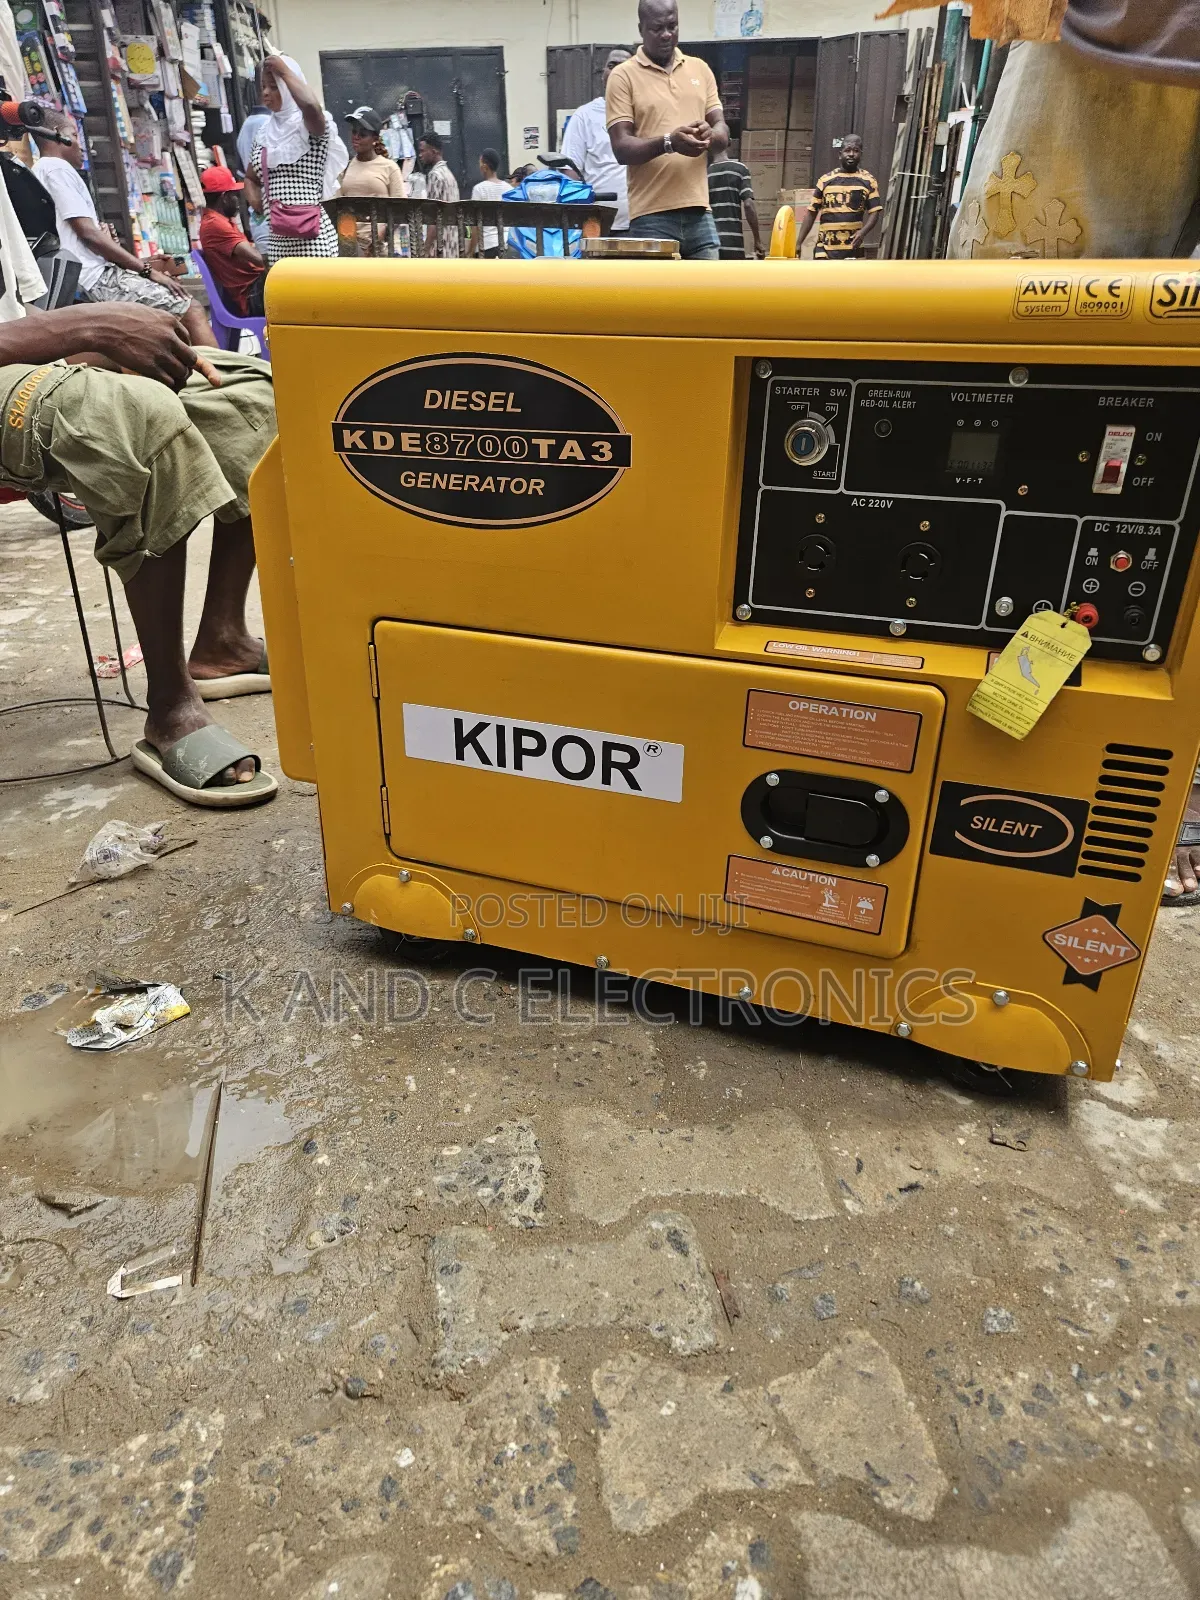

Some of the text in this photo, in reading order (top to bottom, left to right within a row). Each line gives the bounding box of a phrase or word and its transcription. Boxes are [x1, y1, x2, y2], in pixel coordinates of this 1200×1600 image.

[1022, 280, 1068, 295] AVR
[1024, 303, 1061, 314] system
[774, 386, 848, 397] STARTER SW.
[868, 390, 911, 398] GREEN-RUN
[423, 389, 522, 413] DIESEL
[950, 392, 1014, 403] VOLTMETER
[1098, 397, 1154, 408] BREAKER
[860, 399, 916, 409] RED-OIL ALERT
[1145, 432, 1162, 442] ON
[342, 429, 613, 462] KDE8700TA3
[400, 471, 545, 496] GENERATOR
[1132, 477, 1154, 487] OFF
[851, 498, 893, 509] AC 220V
[1094, 522, 1161, 536] DC 12V/8.3A
[1085, 556, 1098, 566] ON
[1140, 560, 1159, 570] OFF
[1029, 634, 1076, 662] ВНИМАНИЕ
[788, 700, 877, 722] OPERATION
[970, 815, 1043, 838] SILENT
[781, 868, 837, 887] CAUTION
[1053, 933, 1130, 958] SILENT
